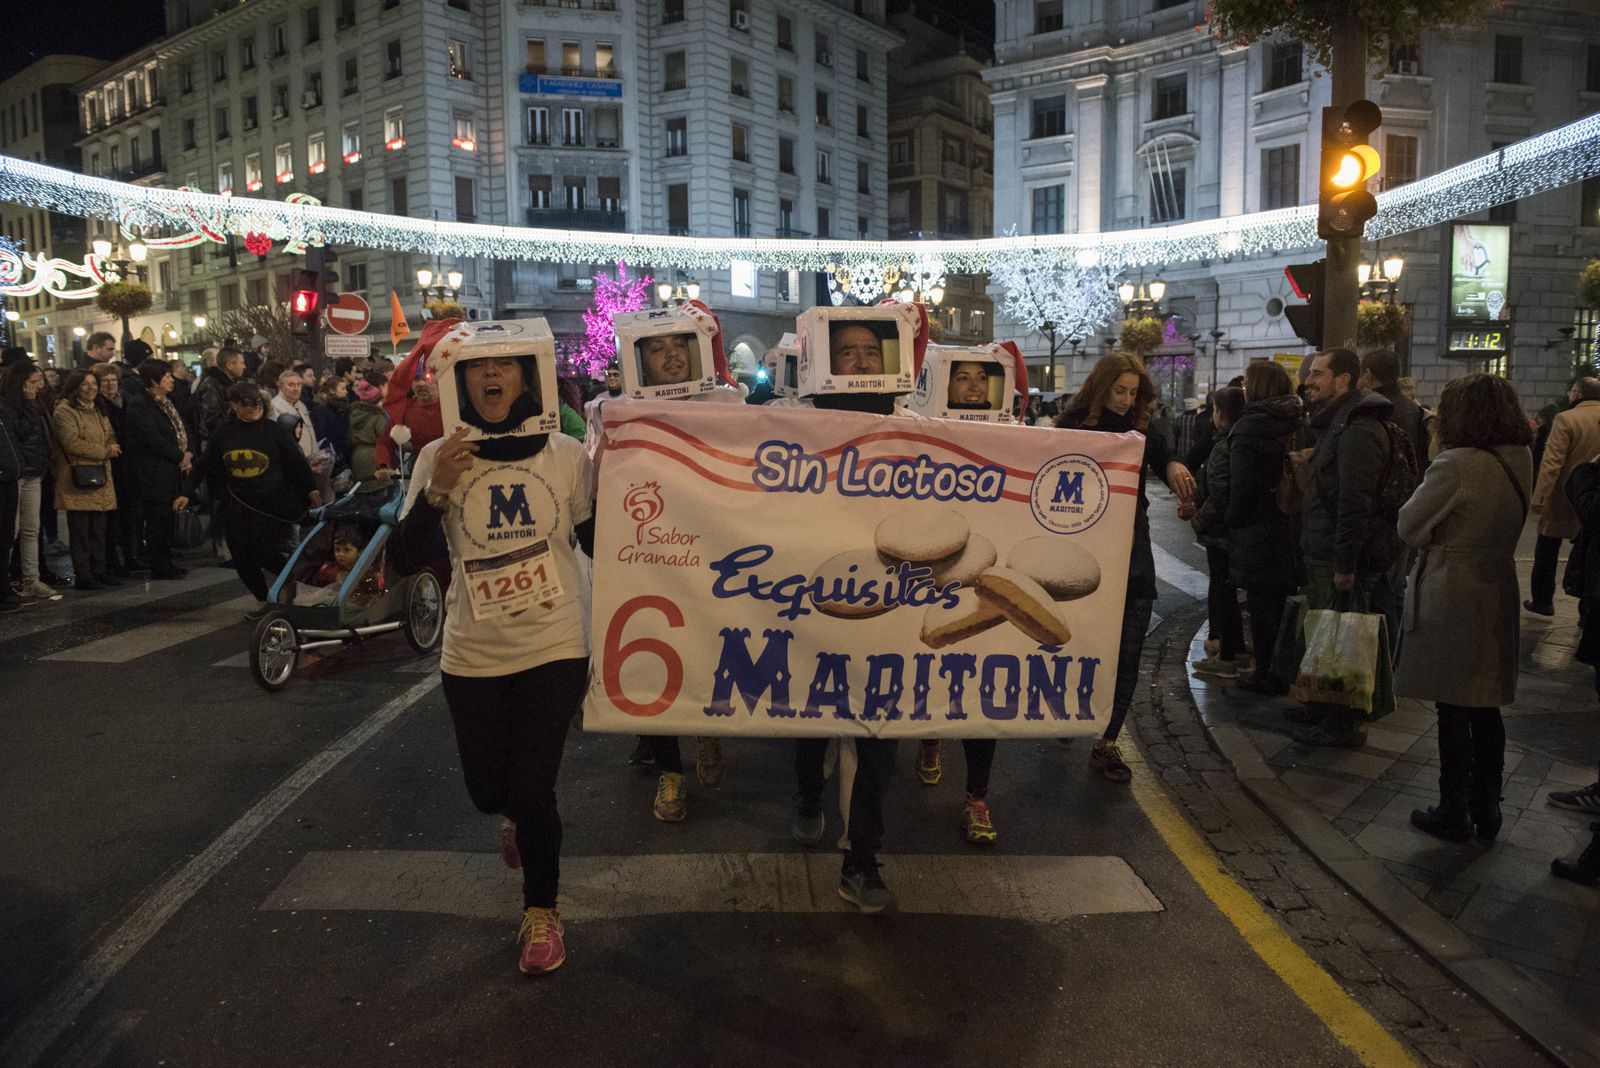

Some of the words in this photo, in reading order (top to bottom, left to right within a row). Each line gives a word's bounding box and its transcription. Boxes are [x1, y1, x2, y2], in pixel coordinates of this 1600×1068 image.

[655, 387, 689, 397] MARITOÑI
[847, 380, 886, 389] MARITOÑI
[754, 441, 826, 493] Sin
[838, 447, 1005, 502] Lactosa
[1050, 470, 1085, 505] M
[486, 483, 536, 528] M
[487, 528, 536, 542] MARITOÑI
[647, 526, 700, 546] Sabor
[617, 545, 700, 567] Granada
[476, 563, 549, 602] 1261
[709, 544, 961, 621] Exquisitas
[602, 594, 685, 717] 6
[702, 627, 1101, 722] MARITOÑI
